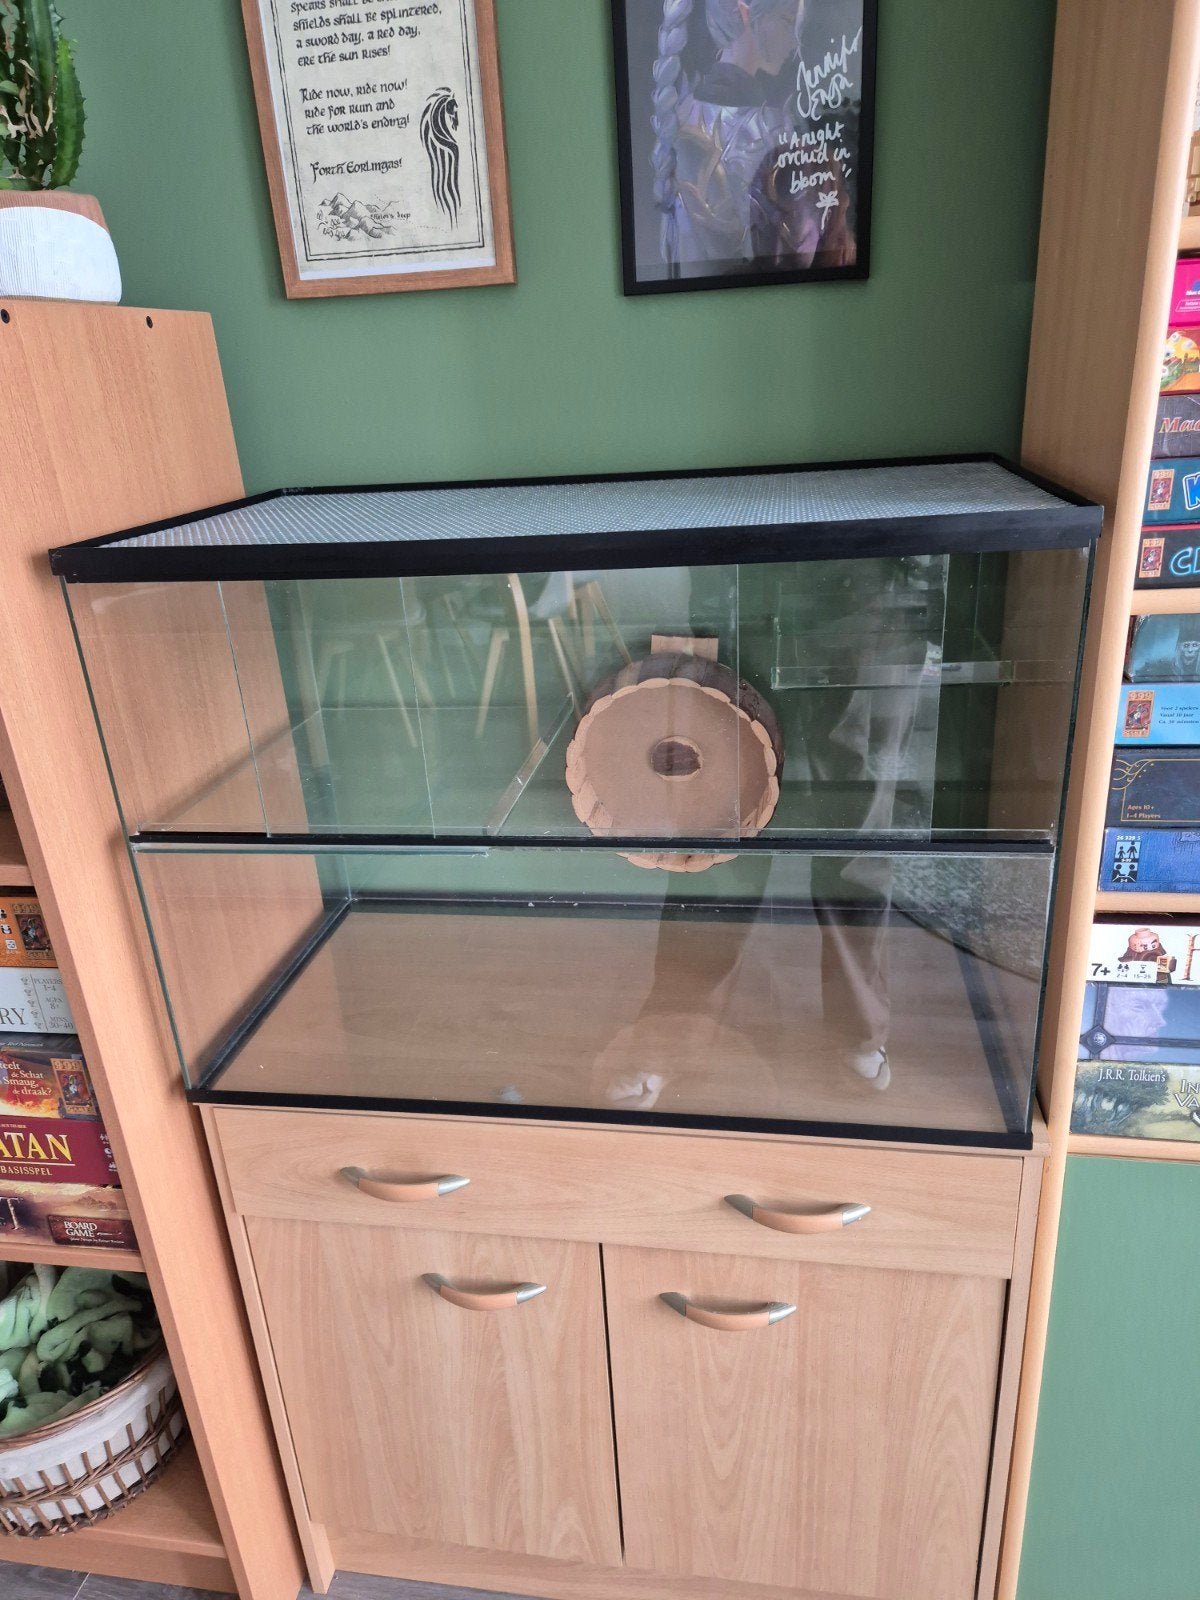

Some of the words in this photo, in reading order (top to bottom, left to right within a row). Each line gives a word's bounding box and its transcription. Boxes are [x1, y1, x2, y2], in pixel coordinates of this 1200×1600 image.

[1091, 963, 1111, 976] 7+
[1098, 1068, 1125, 1082] J.R.R.
[1128, 1068, 1166, 1082] Tolkien's
[21, 1086, 52, 1096] draak?
[63, 1221, 98, 1231] BOARD
[65, 1229, 95, 1238] GAME
